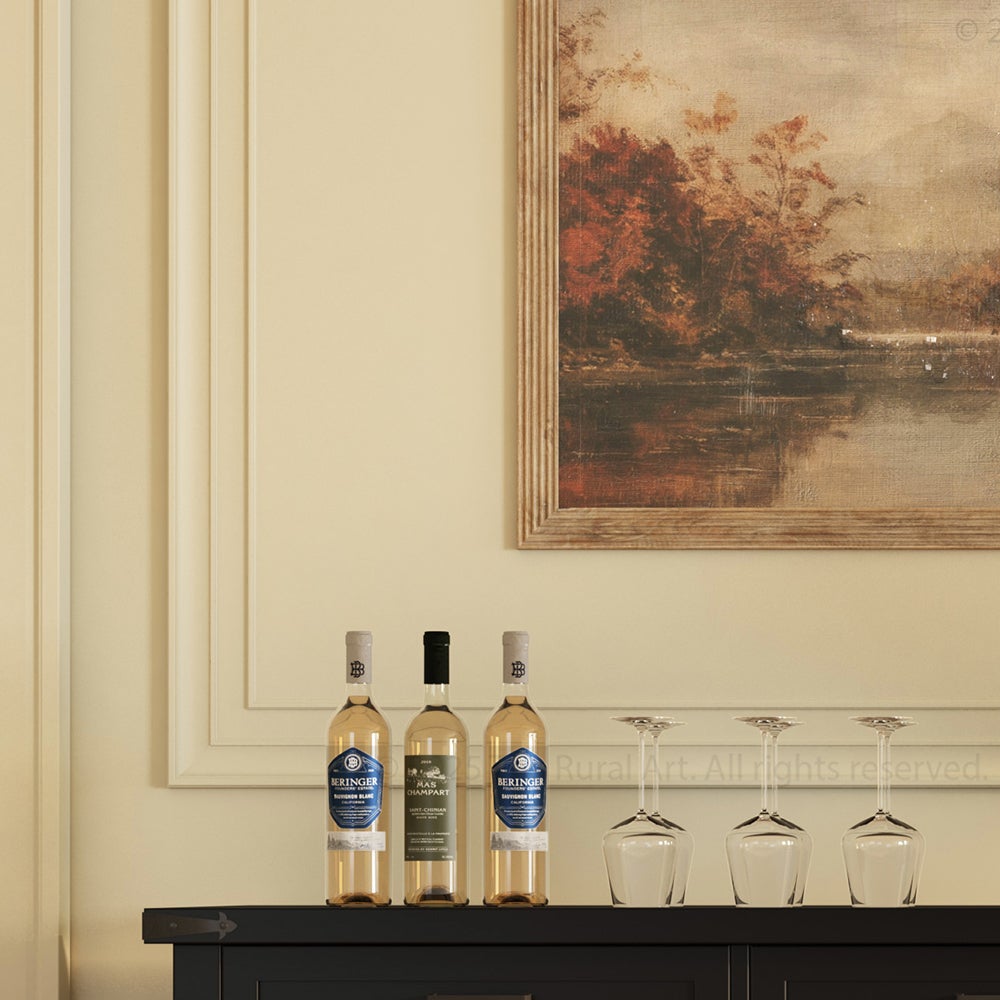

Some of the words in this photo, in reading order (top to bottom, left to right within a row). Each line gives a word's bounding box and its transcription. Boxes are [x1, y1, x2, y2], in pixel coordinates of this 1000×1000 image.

[331, 777, 378, 786] BERINGER
[416, 781, 437, 789] MAS
[497, 777, 544, 786] BERINGER
